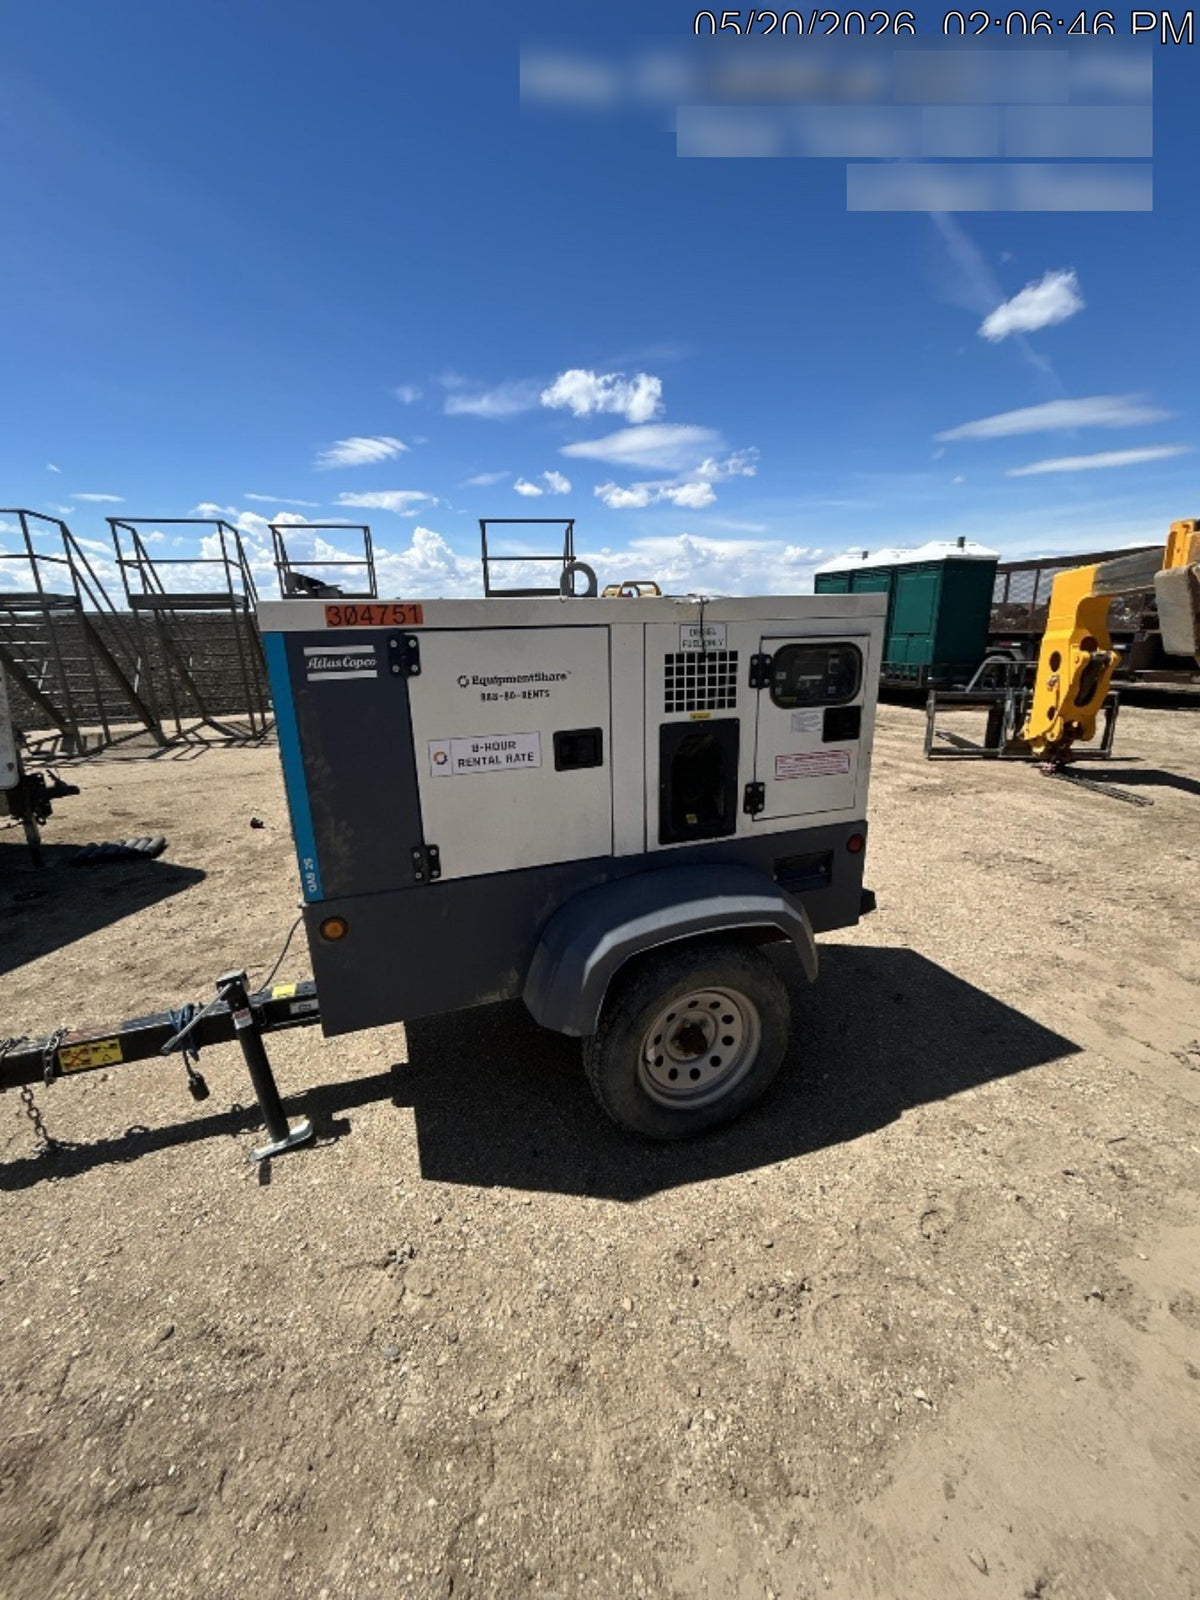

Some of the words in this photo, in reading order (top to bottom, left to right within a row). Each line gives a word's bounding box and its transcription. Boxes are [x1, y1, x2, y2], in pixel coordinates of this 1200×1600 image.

[327, 604, 420, 626] 304751
[307, 656, 341, 669] Atlas
[342, 656, 377, 669] Copco
[472, 672, 567, 686] EquipmentShare
[472, 741, 516, 752] 8-HOUR
[458, 756, 501, 768] RENTAL
[506, 752, 534, 764] RATE
